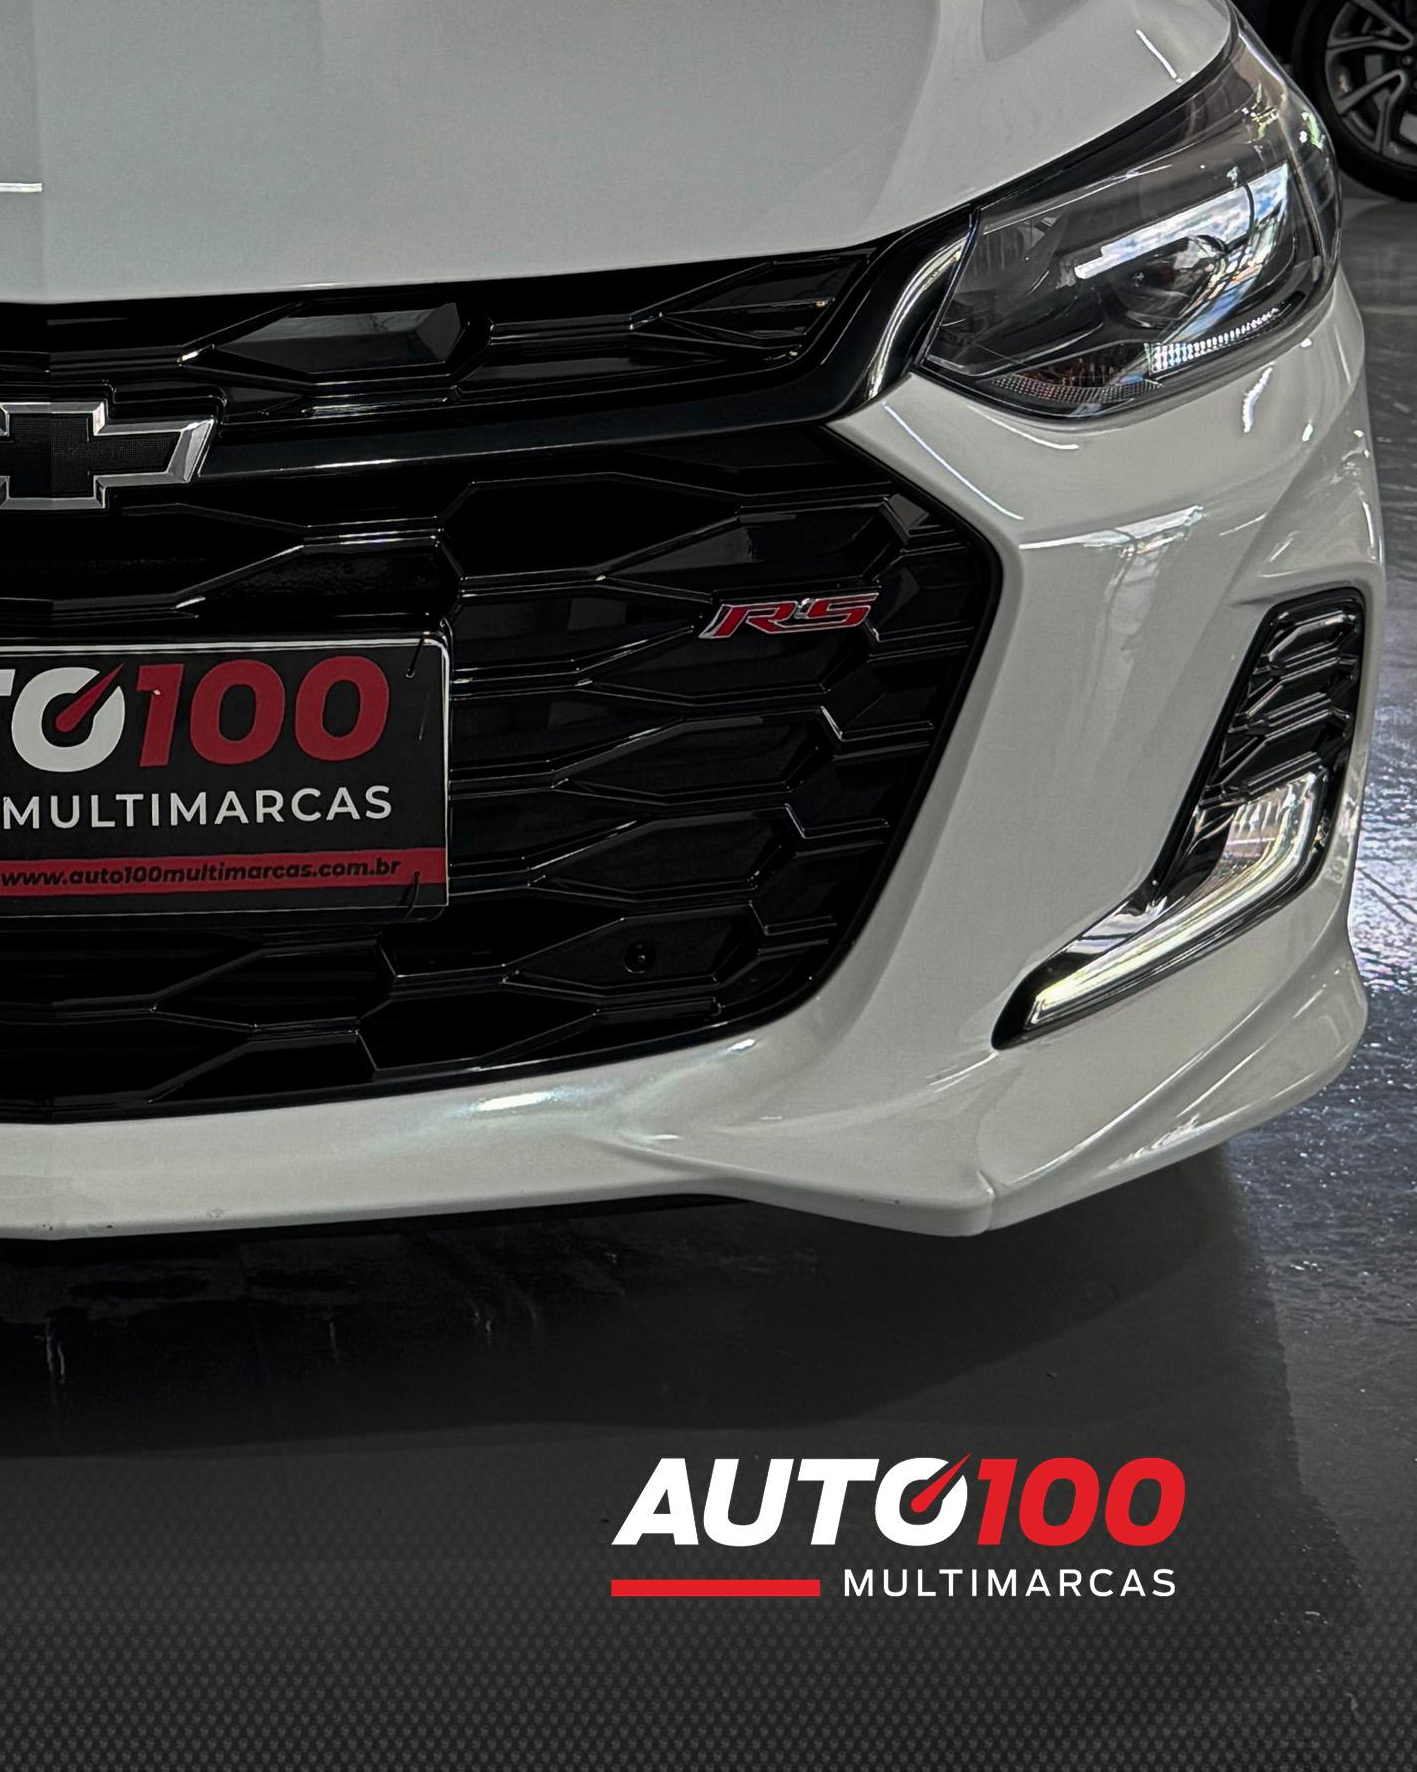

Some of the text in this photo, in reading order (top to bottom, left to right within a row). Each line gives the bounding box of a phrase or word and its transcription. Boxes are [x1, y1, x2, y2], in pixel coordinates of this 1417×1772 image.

[698, 592, 880, 639] RS
[2, 784, 393, 830] MULTIMARCAS
[0, 857, 402, 888] www.auto100multimarcas.com.br
